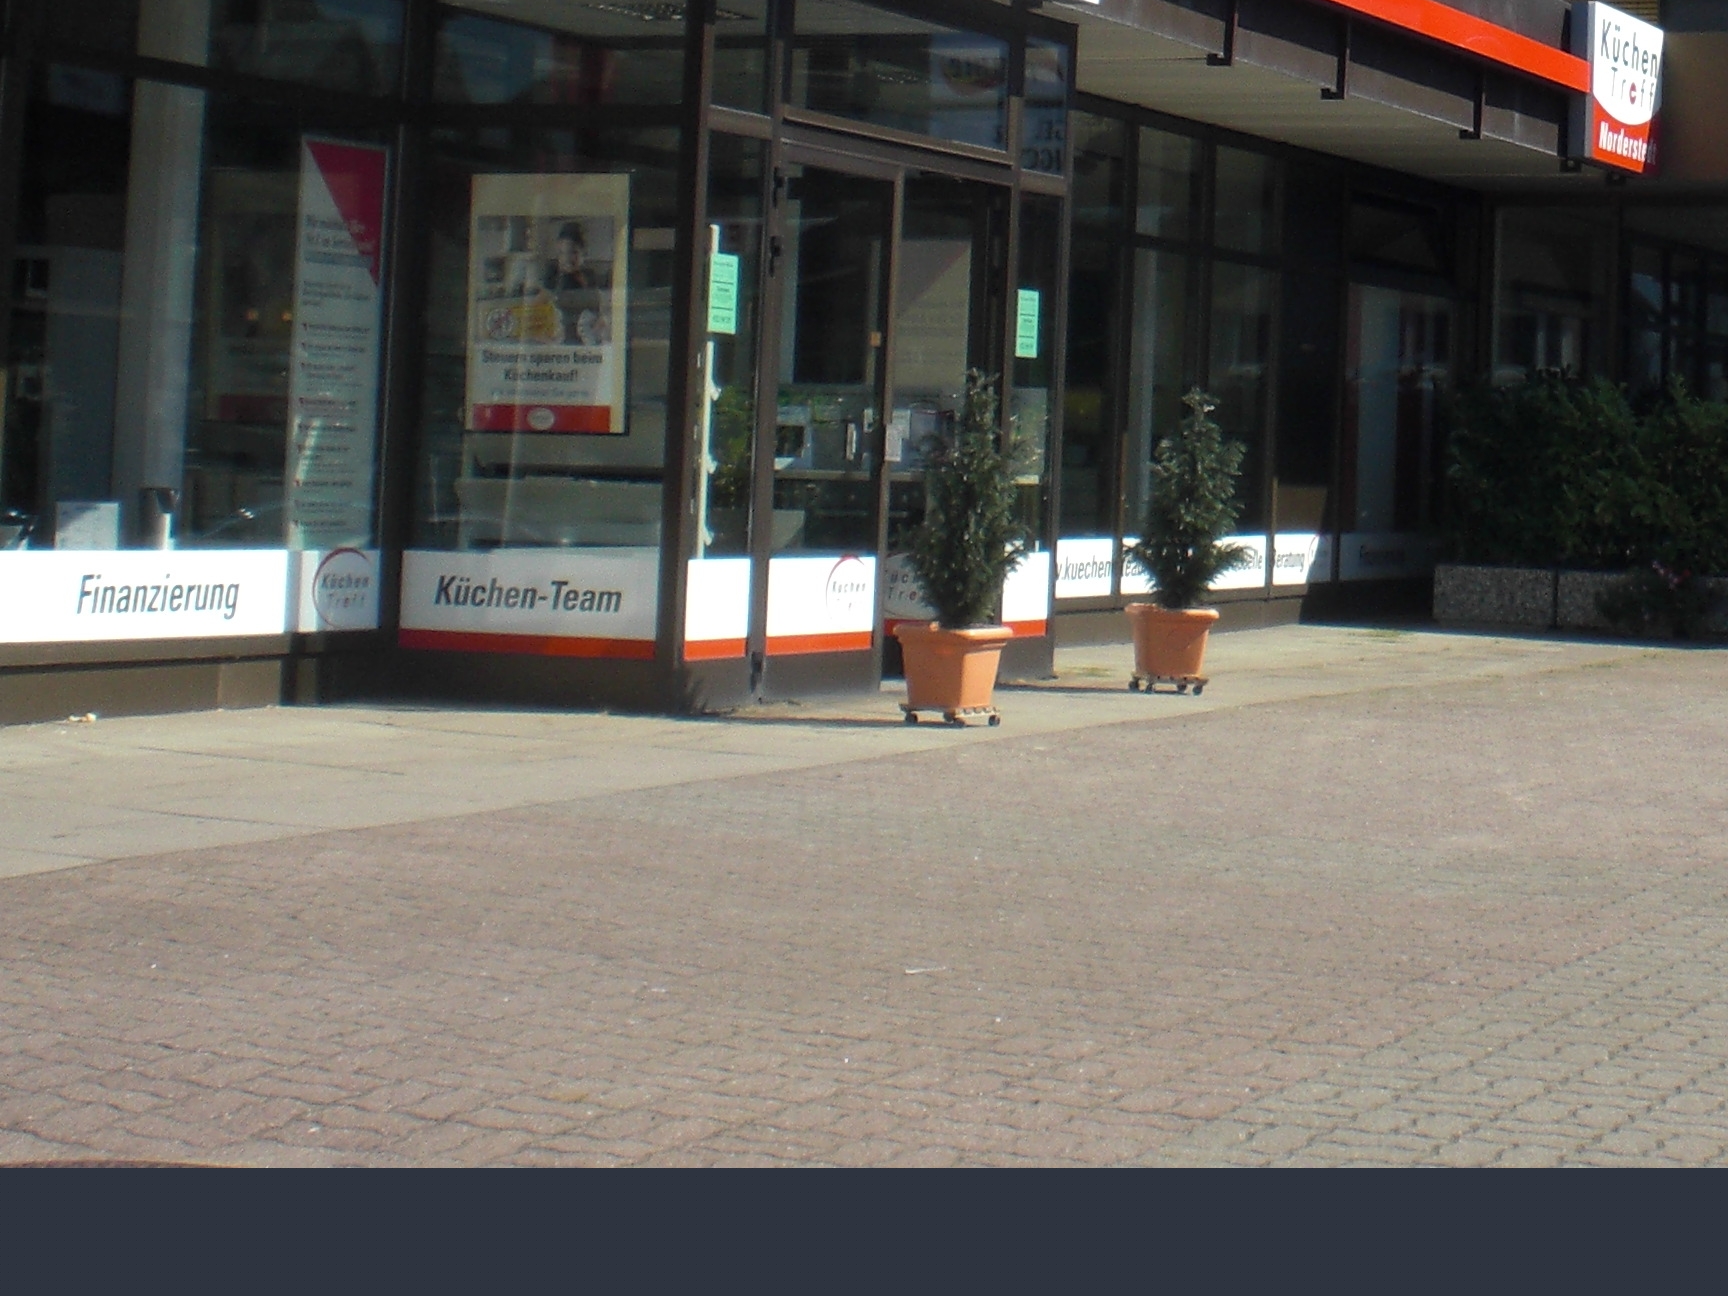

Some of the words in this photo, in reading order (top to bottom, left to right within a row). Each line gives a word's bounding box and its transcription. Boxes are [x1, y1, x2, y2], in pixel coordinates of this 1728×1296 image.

[1601, 18, 1658, 80] Küchen
[1611, 66, 1655, 112] Treff
[1598, 120, 1658, 165] Norderstedt
[76, 574, 240, 620] Finanzierung
[435, 575, 622, 613] Küchen-Team
